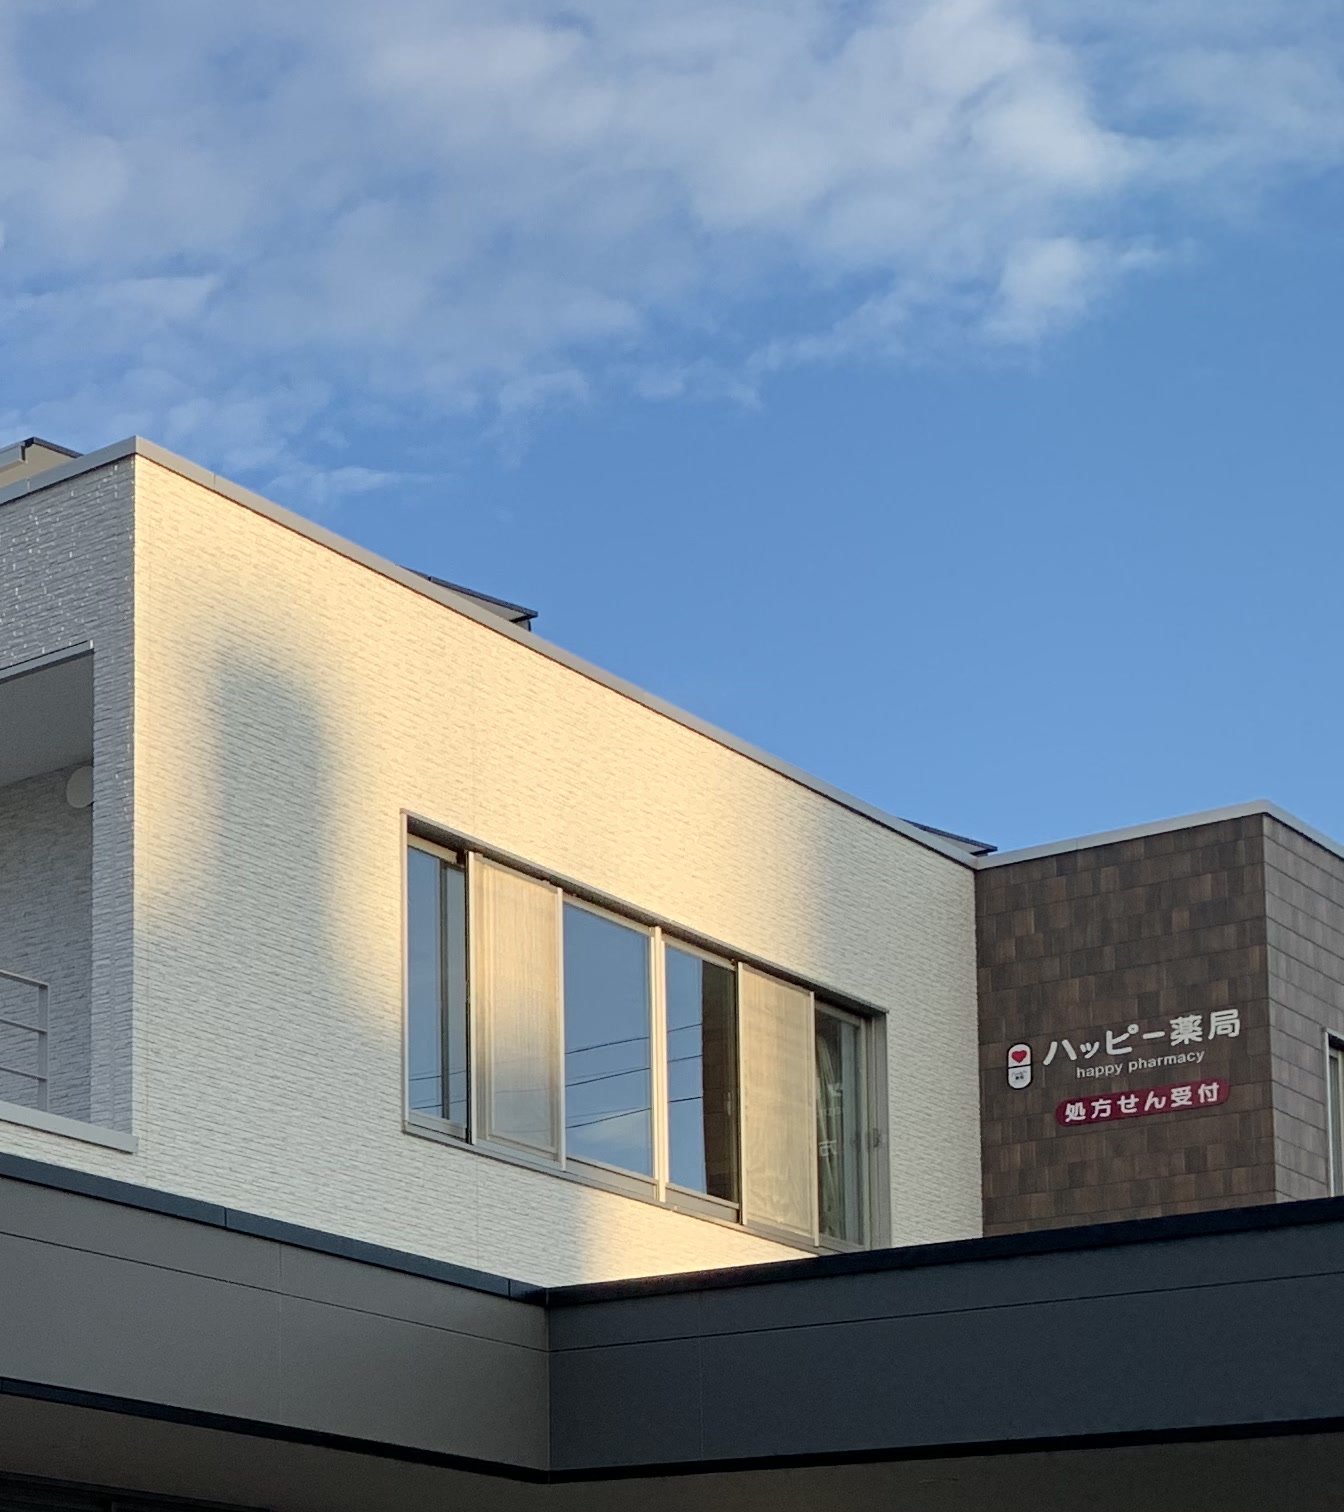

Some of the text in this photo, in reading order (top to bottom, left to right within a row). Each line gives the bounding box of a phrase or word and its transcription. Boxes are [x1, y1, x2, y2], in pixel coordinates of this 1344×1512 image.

[1043, 1008, 1241, 1066] ハッピー薬局
[1076, 1048, 1205, 1079] happy pharmacy
[1064, 1081, 1220, 1123] 処方せん受付
